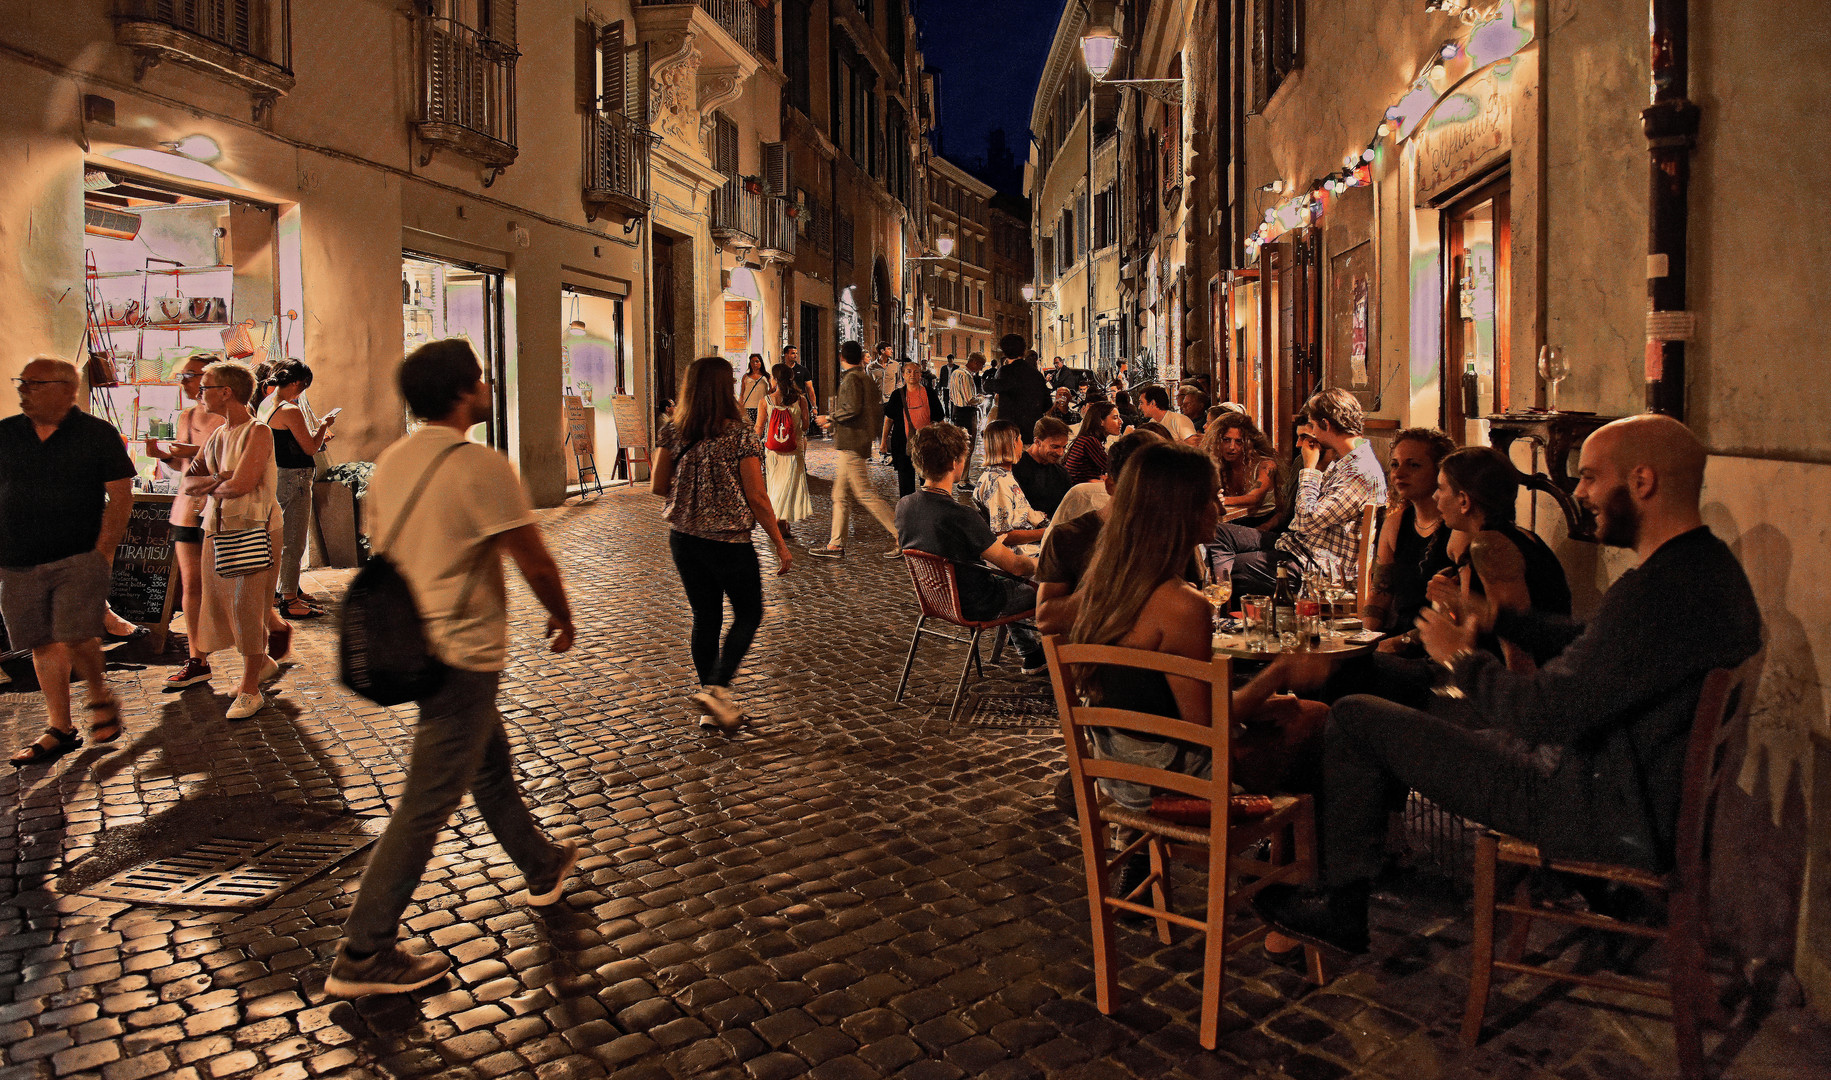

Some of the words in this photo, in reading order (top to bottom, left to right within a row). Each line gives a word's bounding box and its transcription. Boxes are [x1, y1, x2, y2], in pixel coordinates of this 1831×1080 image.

[146, 527, 170, 546] best
[125, 563, 135, 572] in
[142, 558, 171, 574] town
